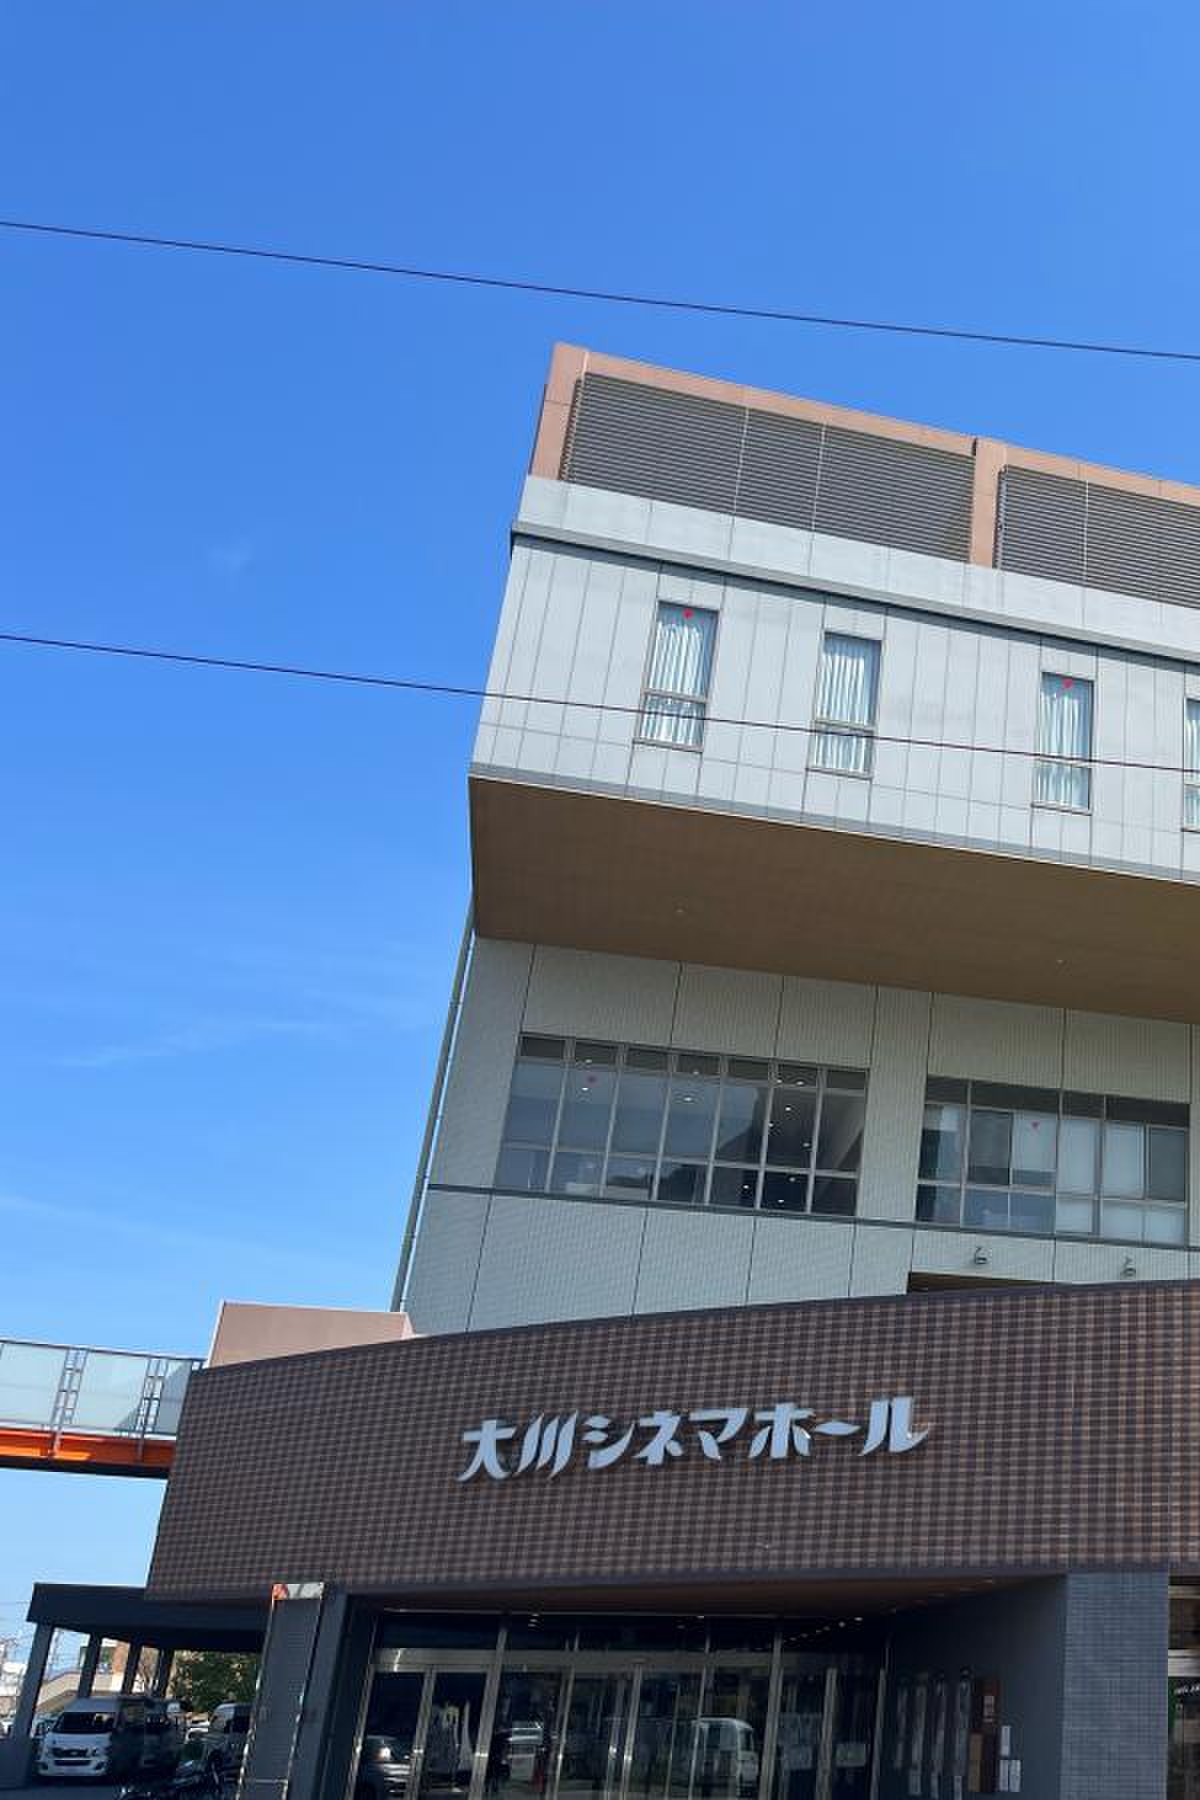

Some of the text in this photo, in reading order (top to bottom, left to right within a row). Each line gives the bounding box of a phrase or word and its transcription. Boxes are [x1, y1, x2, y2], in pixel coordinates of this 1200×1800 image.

[457, 1397, 929, 1482] 大川シネマホール
